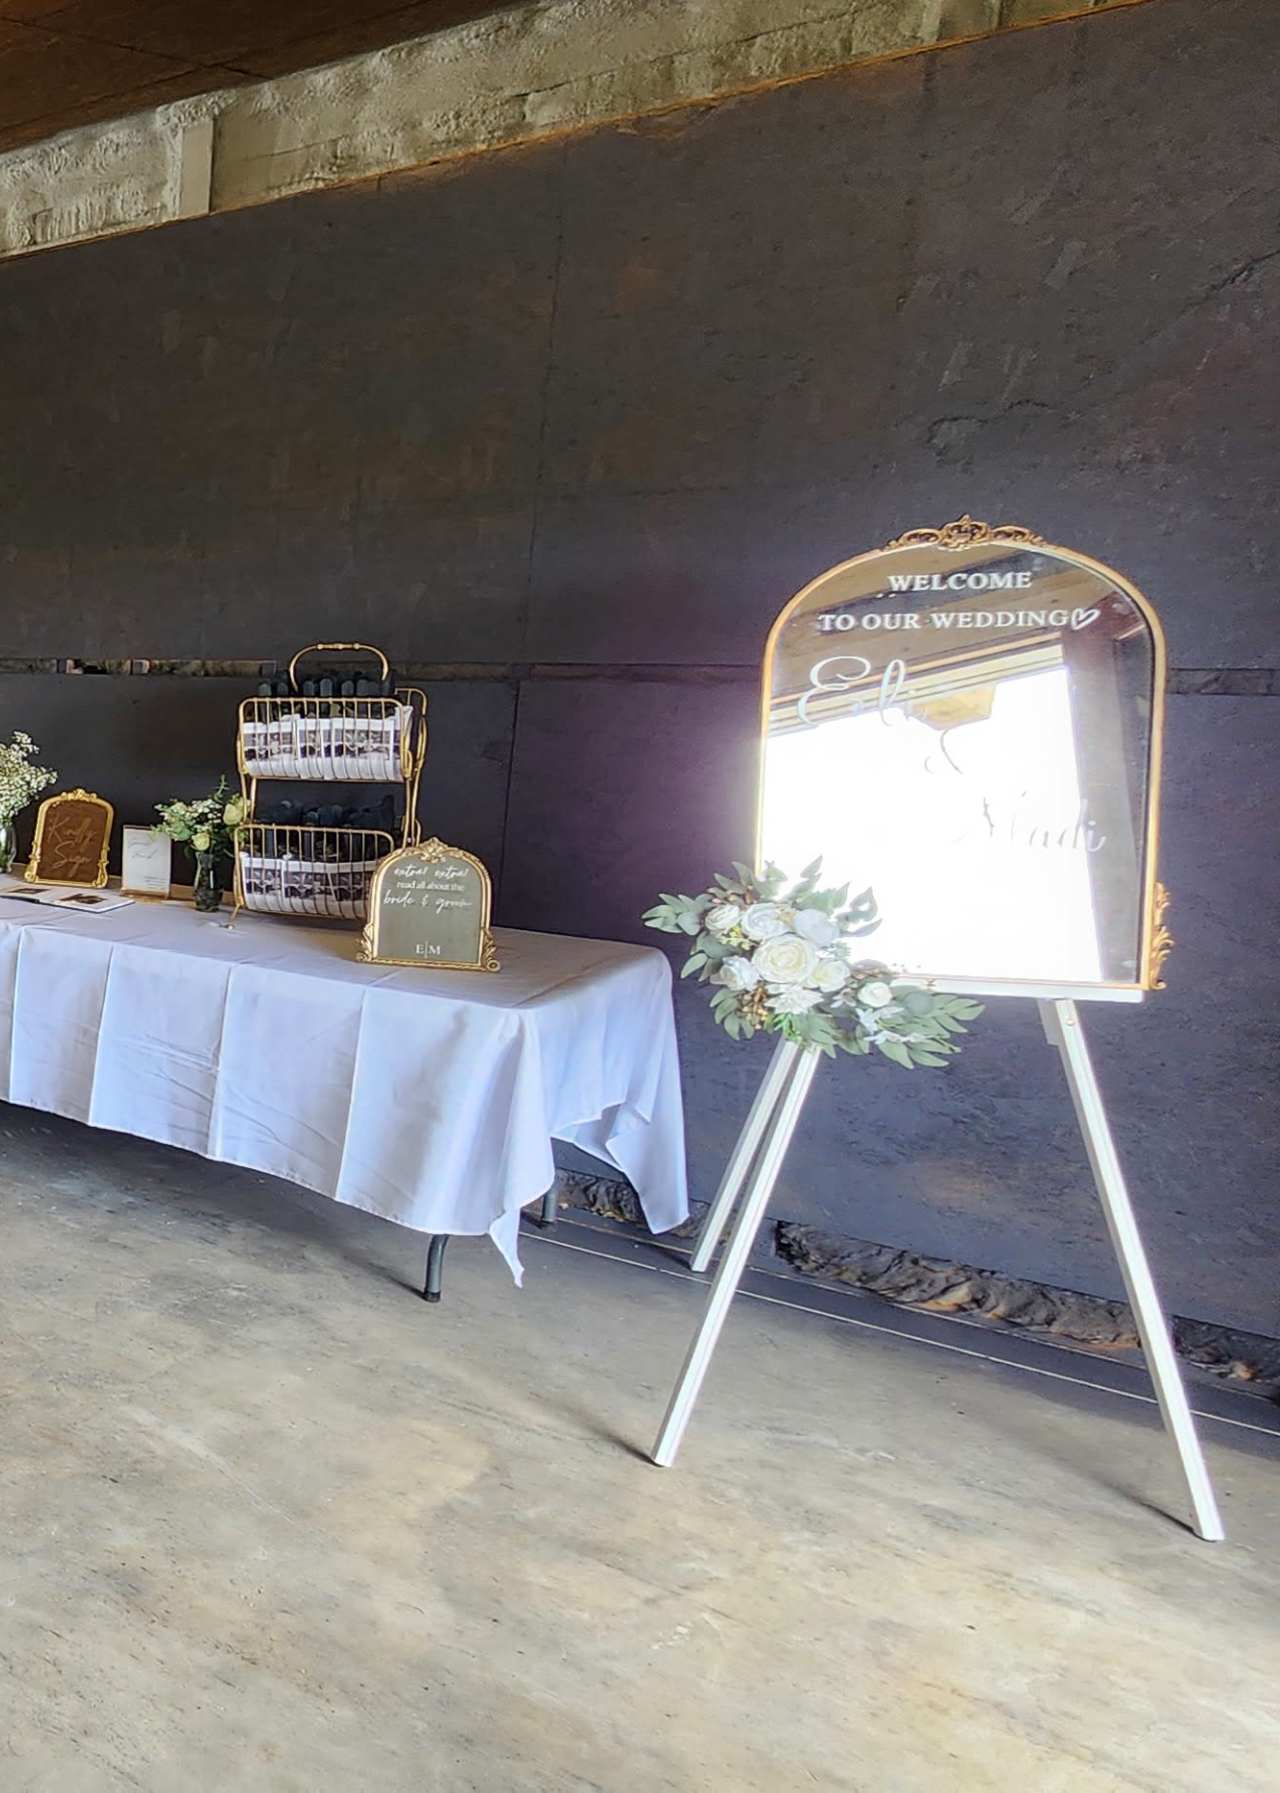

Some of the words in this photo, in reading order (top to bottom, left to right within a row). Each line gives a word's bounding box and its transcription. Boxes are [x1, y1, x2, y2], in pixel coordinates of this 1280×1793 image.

[887, 571, 1032, 593] WELCOME
[817, 613, 855, 632] TO
[861, 612, 920, 632] OUR
[929, 608, 1070, 630] WEDDING
[50, 839, 93, 879] Sign
[384, 889, 414, 907] bride
